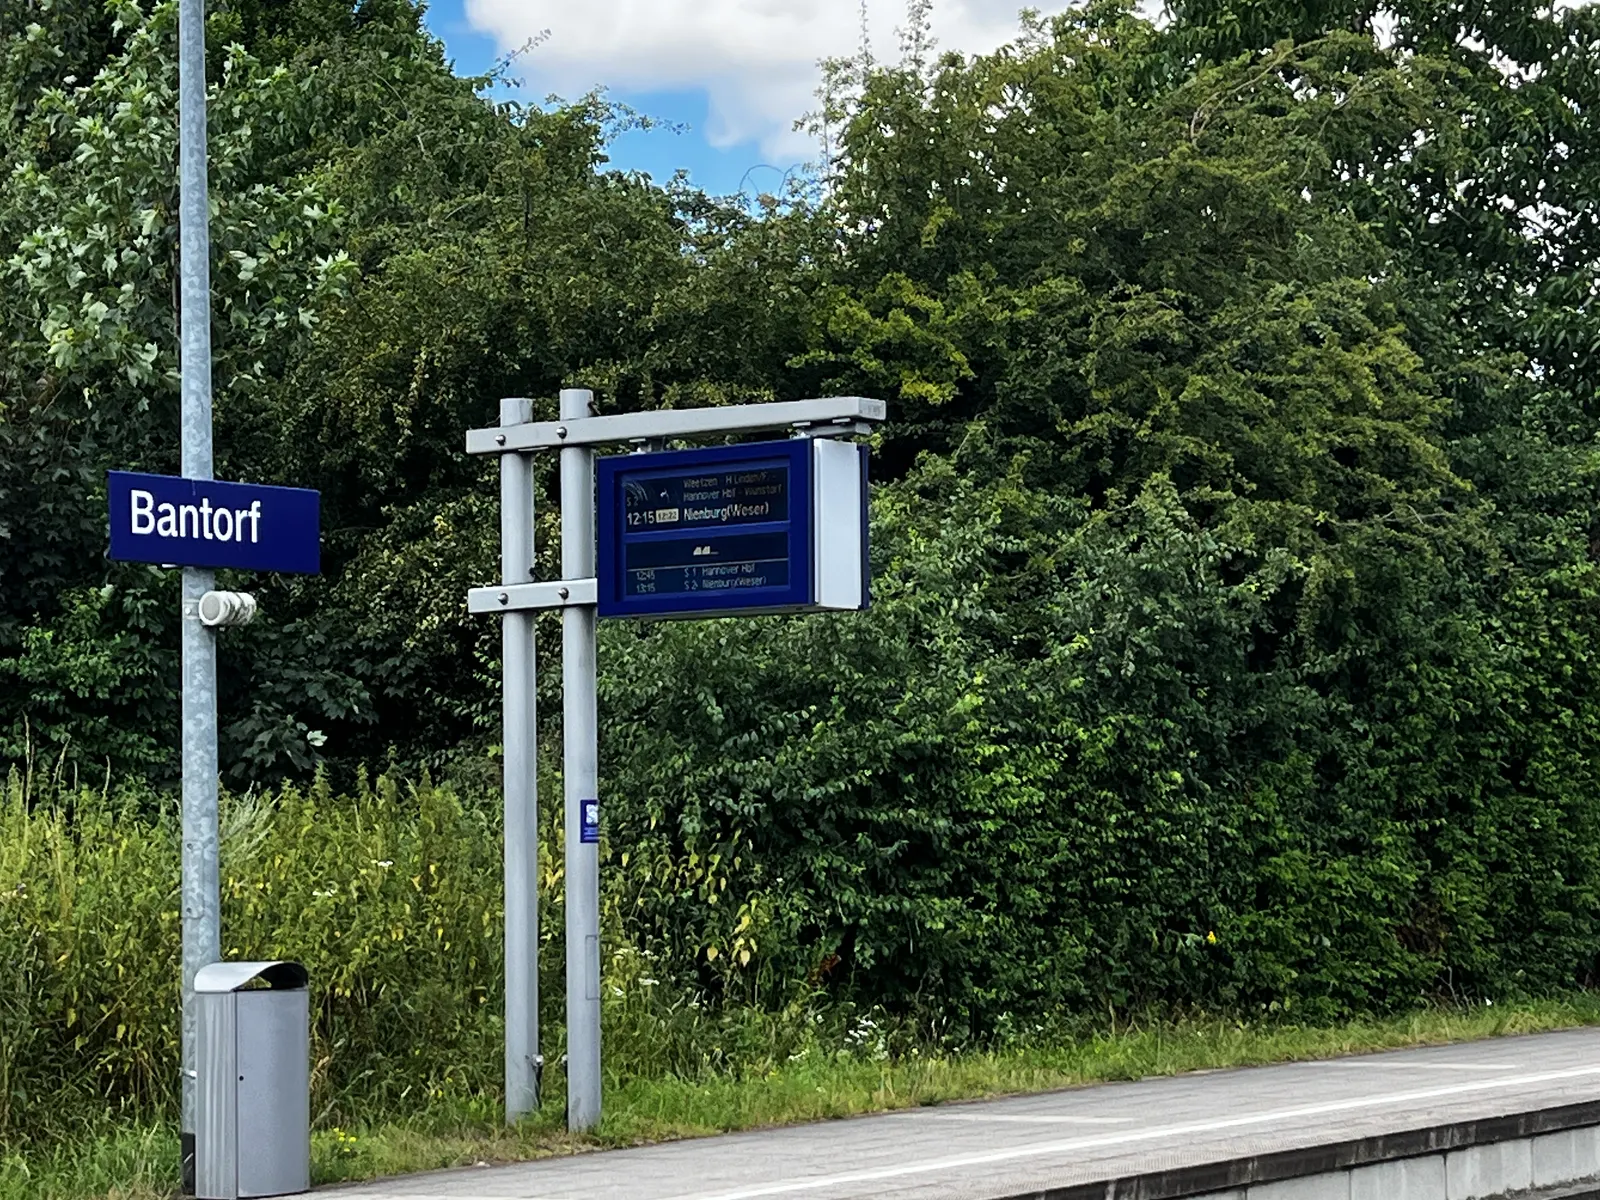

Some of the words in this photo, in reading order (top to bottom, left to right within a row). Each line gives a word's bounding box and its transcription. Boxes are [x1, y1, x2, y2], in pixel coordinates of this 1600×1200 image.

[683, 490, 720, 502] Hannover
[131, 489, 261, 543] Bantorf
[627, 510, 656, 526] 12:15
[683, 501, 769, 522] Nienburg(Weser)
[702, 564, 739, 577] Hannover
